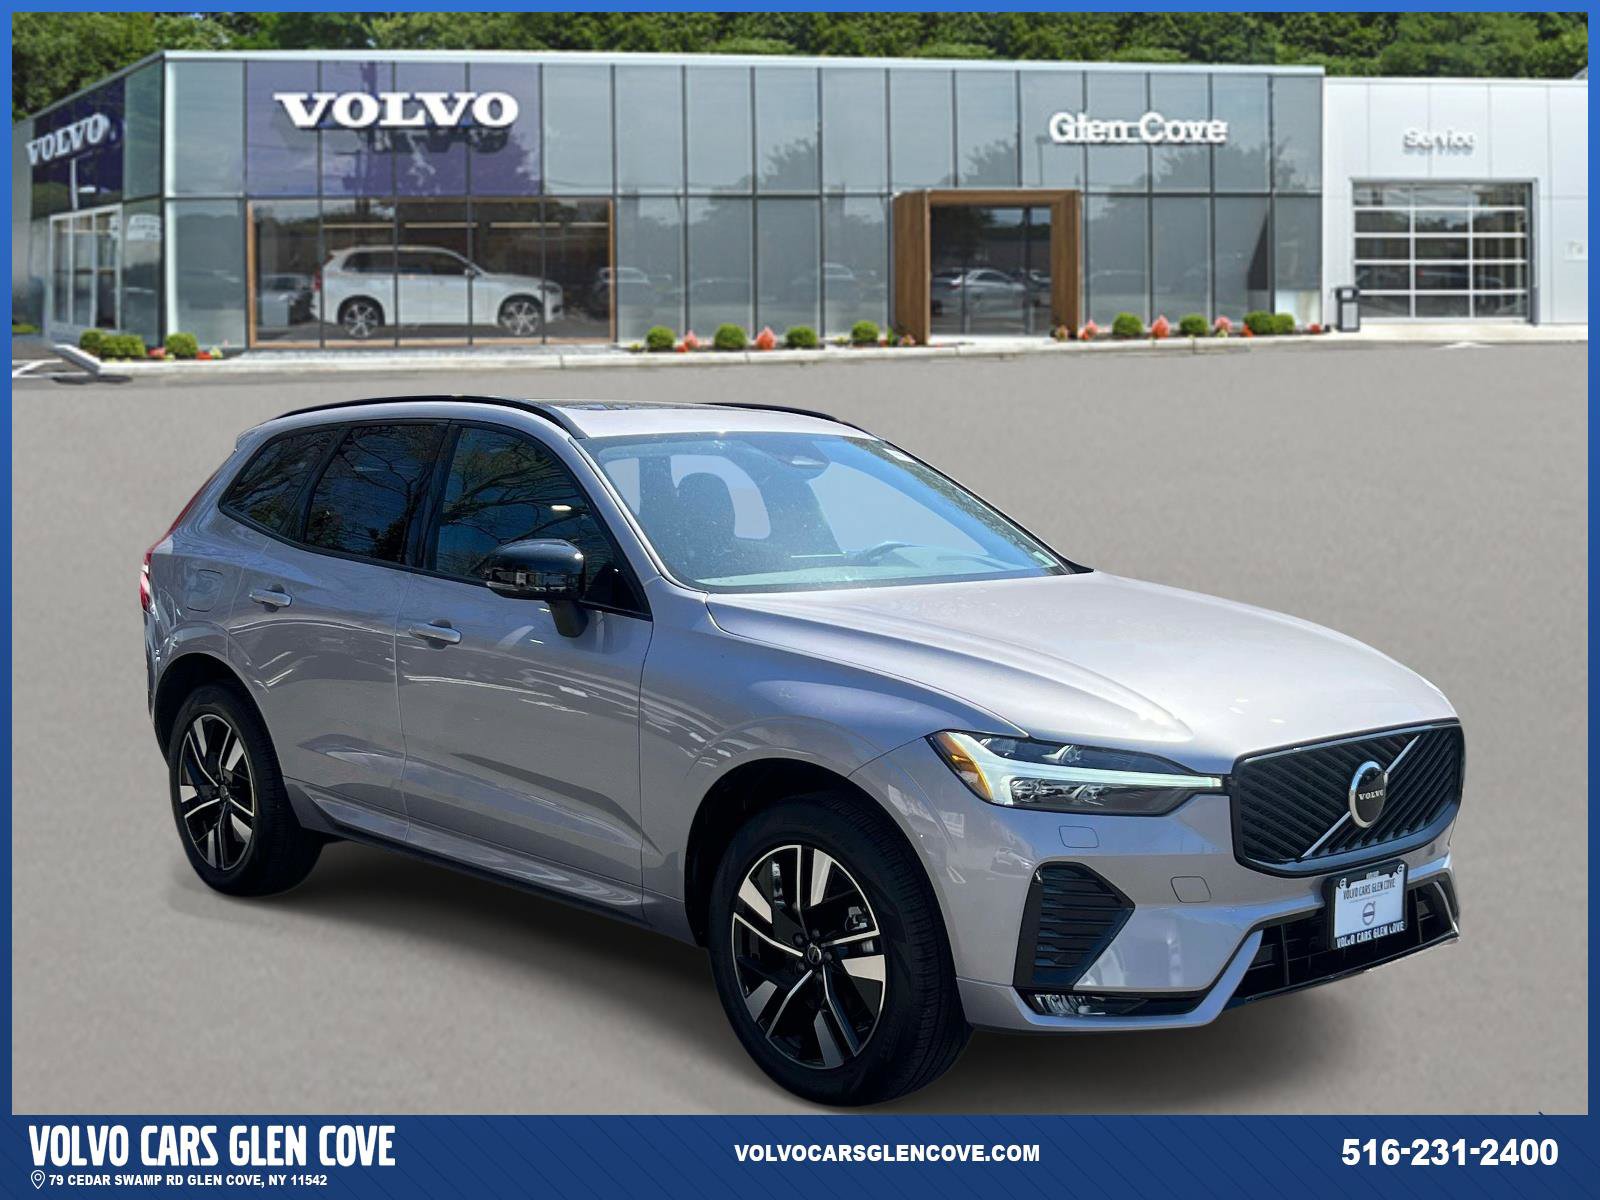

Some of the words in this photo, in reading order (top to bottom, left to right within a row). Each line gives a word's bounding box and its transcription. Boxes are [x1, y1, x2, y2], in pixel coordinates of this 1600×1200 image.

[274, 92, 519, 128] VOLVO
[25, 112, 110, 166] VOLVO
[1049, 112, 1130, 144] Glen
[1137, 111, 1229, 144] Cove
[1402, 127, 1477, 154] Service
[1358, 789, 1385, 801] VOLVO
[1343, 886, 1358, 900] VOLVO
[1358, 884, 1371, 896] CARS
[1371, 881, 1384, 893] GLEN
[1384, 878, 1396, 889] COVE
[1336, 933, 1355, 949] VOLVO
[1356, 928, 1372, 943] CARS
[1373, 924, 1388, 939] GLEN
[1389, 920, 1405, 935] COVE
